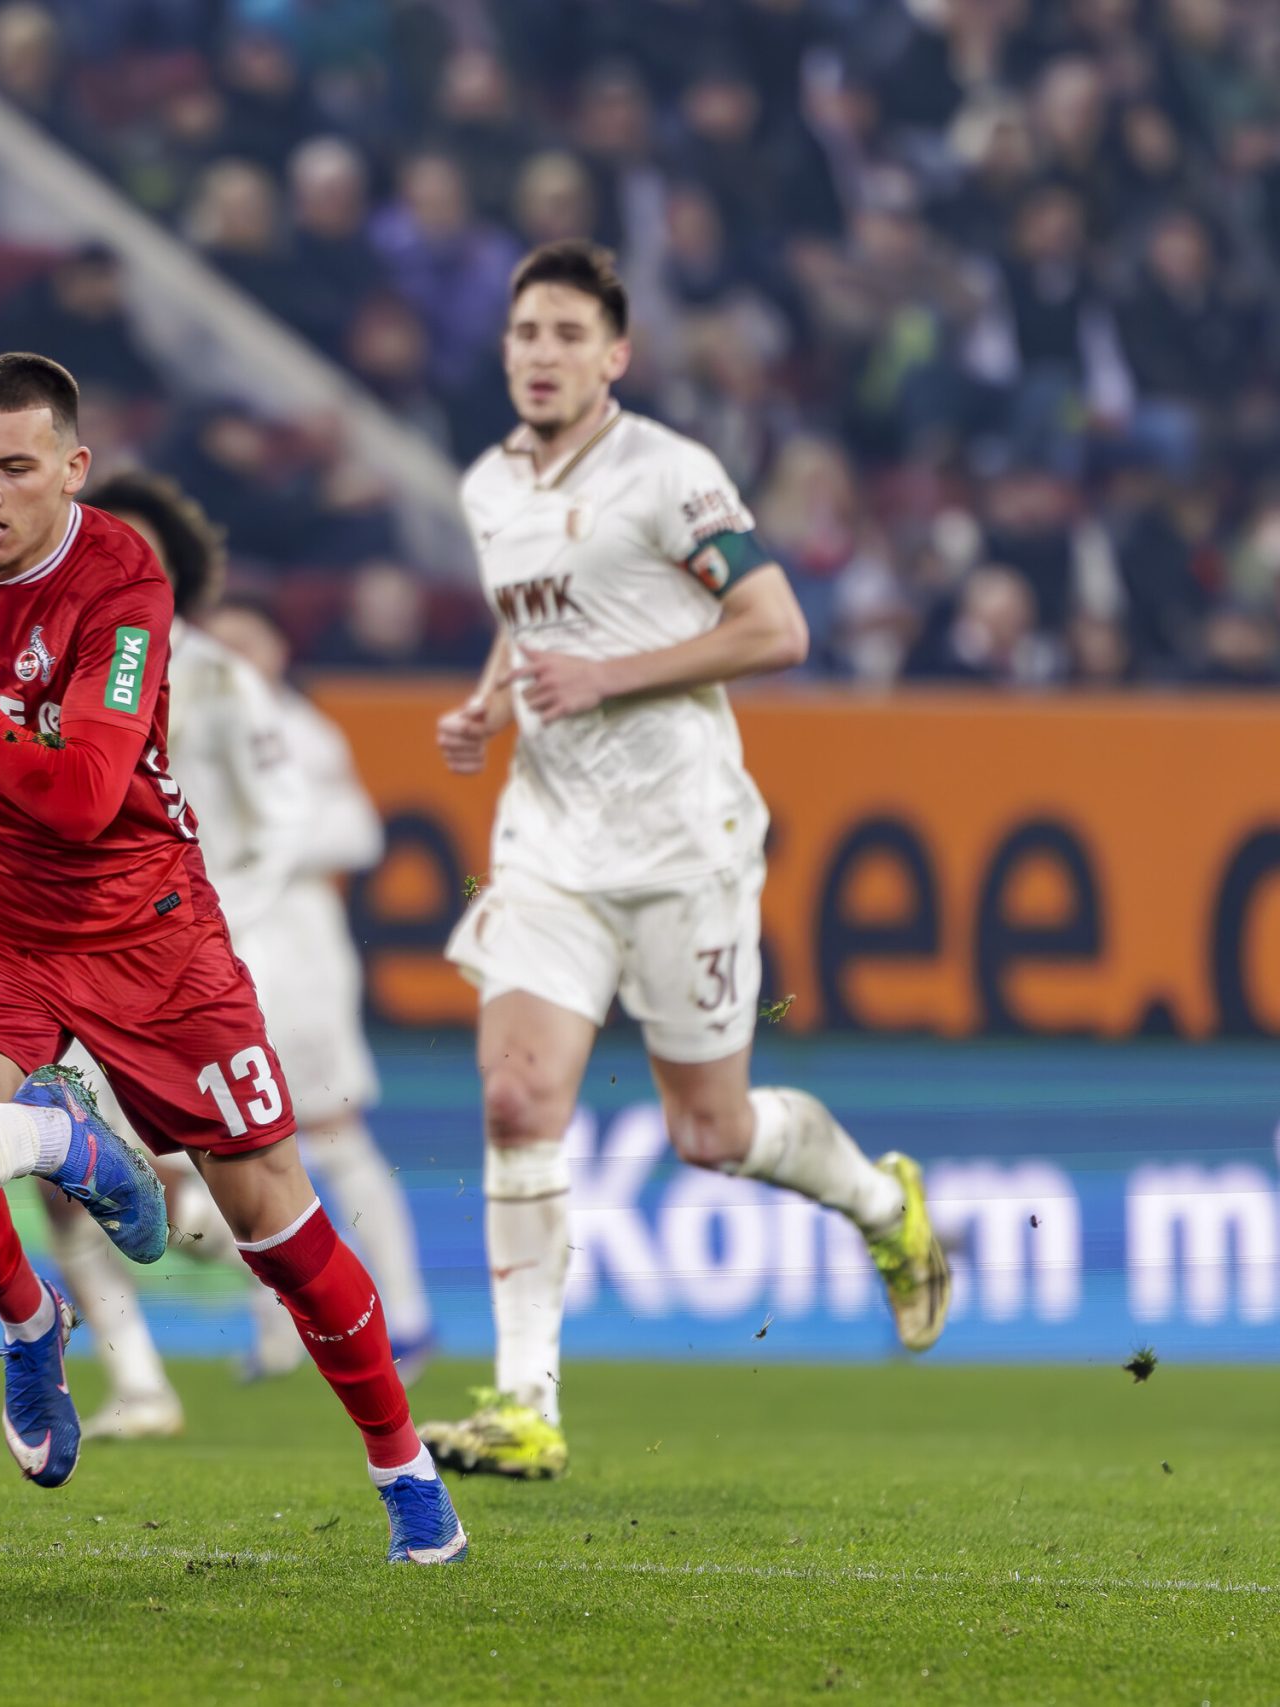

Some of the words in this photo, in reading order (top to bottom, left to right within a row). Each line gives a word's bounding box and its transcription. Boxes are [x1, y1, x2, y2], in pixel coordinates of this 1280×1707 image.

[494, 573, 586, 626] WWK
[113, 635, 144, 706] DEVK
[694, 943, 738, 1012] 31
[196, 1045, 283, 1138] 13
